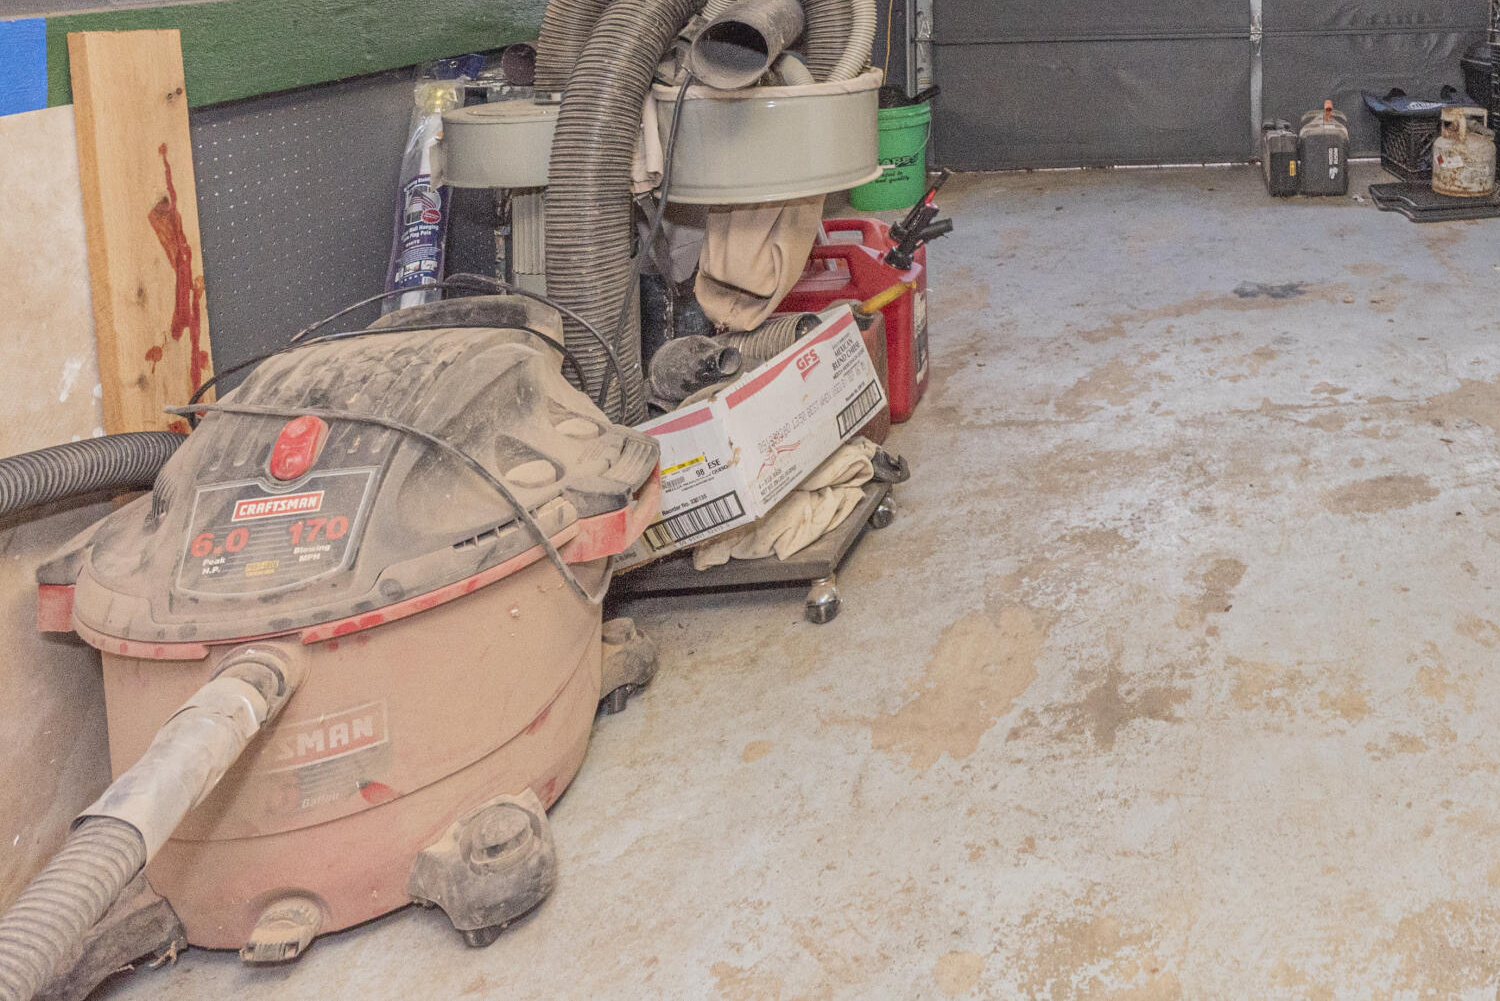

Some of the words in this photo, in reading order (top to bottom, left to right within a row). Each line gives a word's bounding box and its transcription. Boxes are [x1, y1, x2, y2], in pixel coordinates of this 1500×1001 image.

[796, 348, 820, 371] GFS
[708, 458, 721, 469] ESE
[238, 495, 320, 517] CRAFTSMAN
[190, 526, 249, 558] 6.0
[288, 515, 349, 546] 170
[293, 544, 331, 555] Blowing
[202, 556, 226, 567] Peak
[299, 553, 321, 563] MPH
